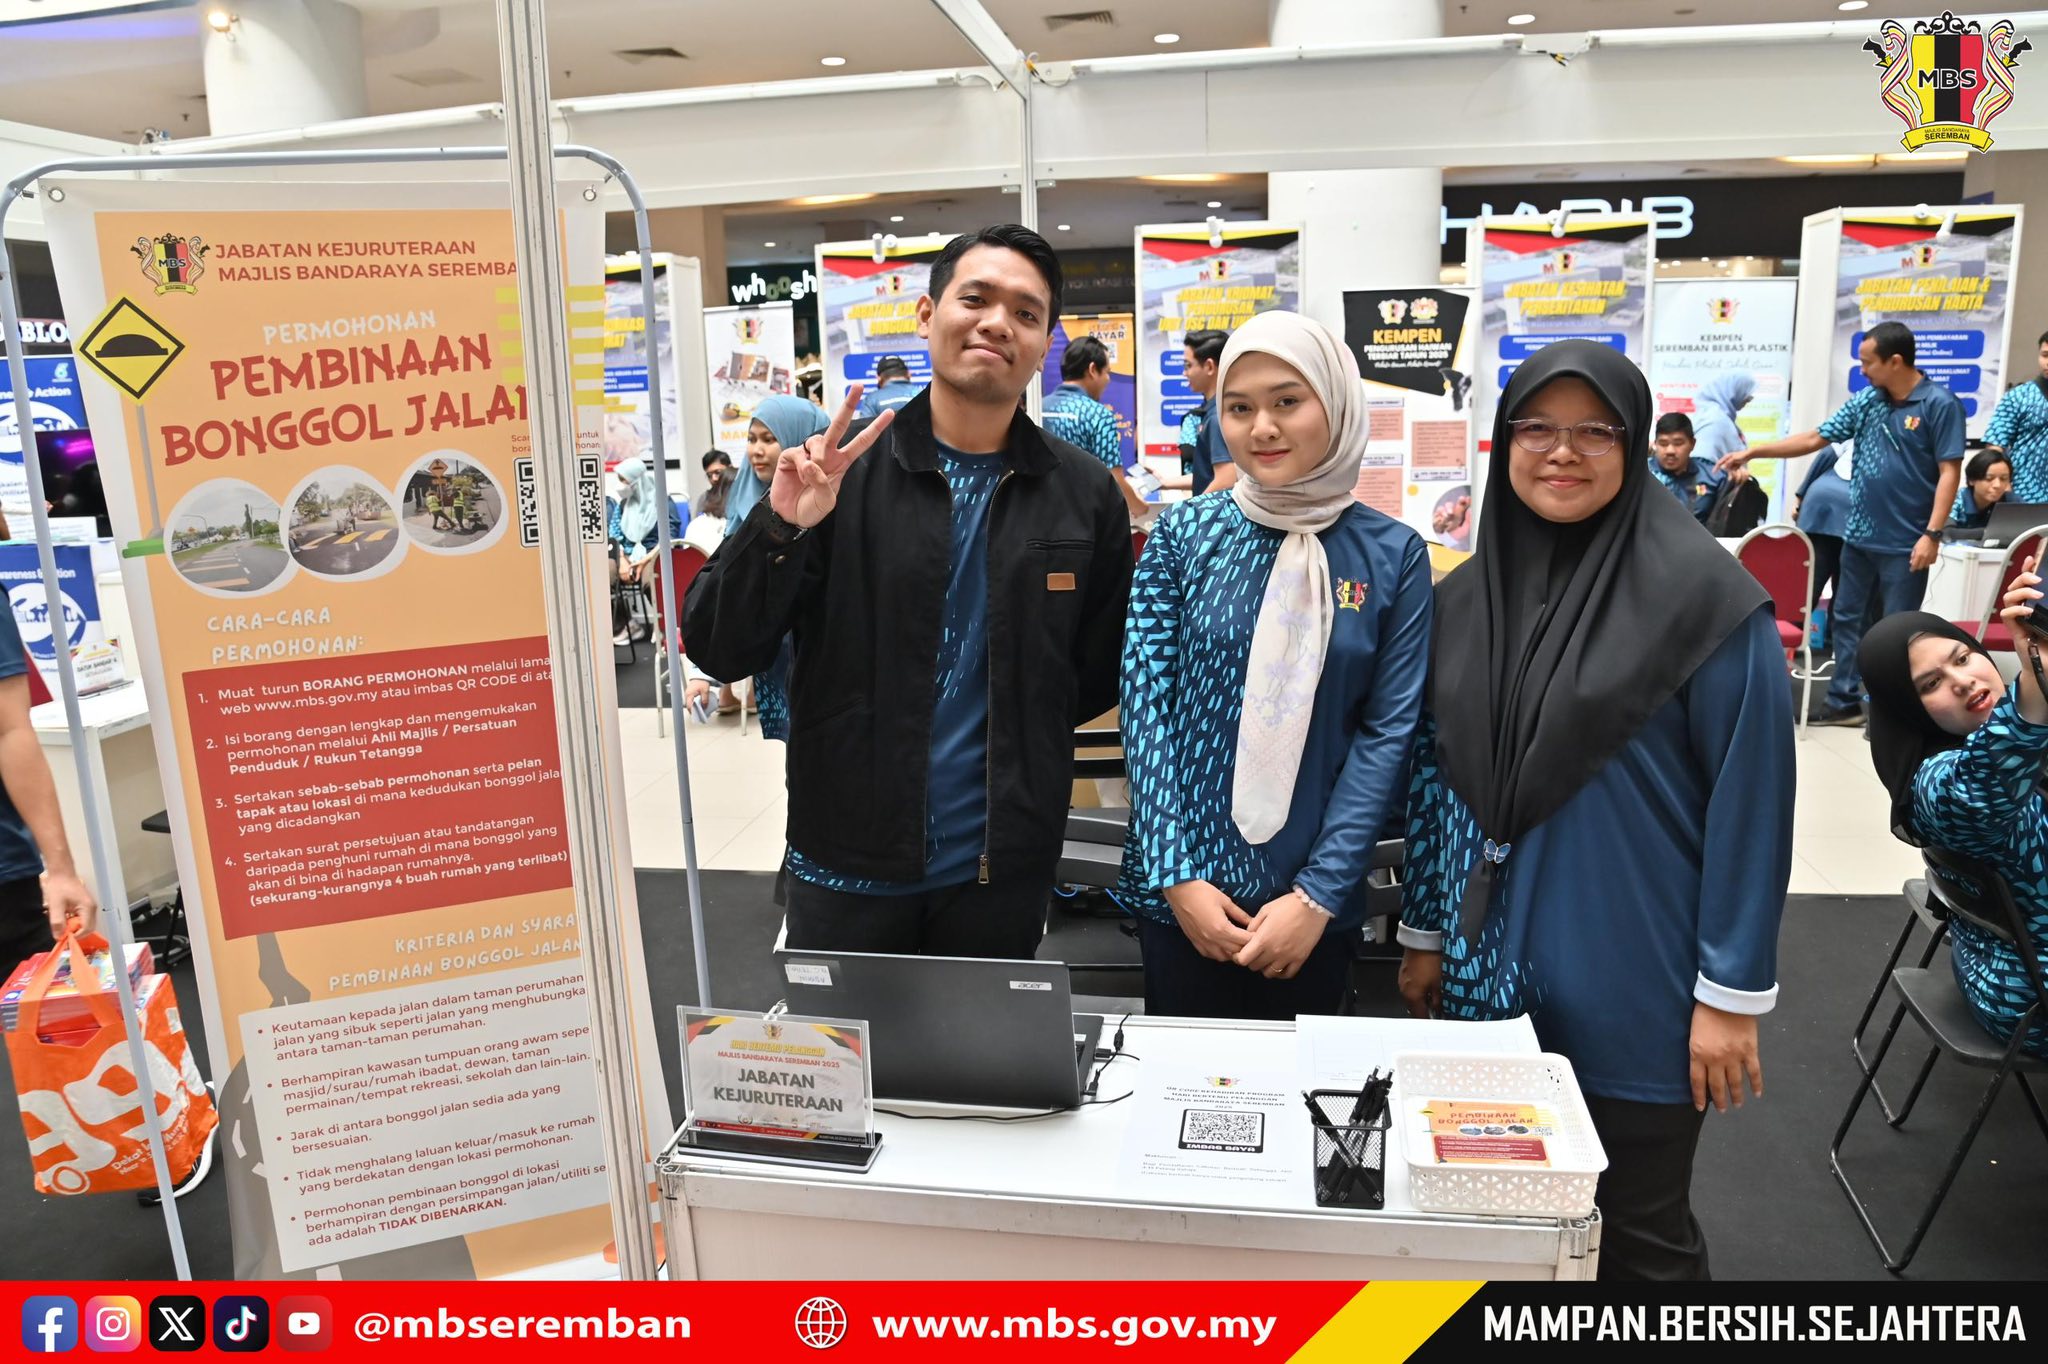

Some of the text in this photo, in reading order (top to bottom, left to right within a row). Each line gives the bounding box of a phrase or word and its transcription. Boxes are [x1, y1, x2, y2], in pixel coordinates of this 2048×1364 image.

[158, 258, 186, 268] MBS
[215, 240, 476, 259] JABATAN KEJURUTERAAN
[218, 261, 518, 282] MAJLIS BANDARAYA SEREMBA
[731, 269, 818, 303] whoosh
[1859, 295, 1985, 311] PENGURUSAN HARTA
[262, 310, 437, 346] PERMOHONAN
[1373, 328, 1442, 344] KEMPEN
[1700, 334, 1743, 342] KEMPEN
[1400, 351, 1428, 359] TAHUN
[1654, 344, 1789, 352] SEREMBAN BEBAS PLASTIK
[210, 333, 493, 400] PEMBINAAN
[34, 386, 73, 398] Action
[160, 403, 395, 468] BONGGOL
[206, 606, 331, 633] CARA-CARA
[211, 635, 365, 665] PERMOHONAN:
[198, 693, 208, 703] 1.
[218, 686, 255, 700] Muat
[261, 684, 299, 695] turun
[302, 675, 363, 691] BORANG
[366, 664, 467, 685] PERMOHONAN
[471, 658, 517, 673] melalui
[205, 702, 537, 749] 2. Isi borang dengan lengkap dan mengemukakan
[227, 719, 517, 762] permohonan melalui Ahli Majlis / Persatuan
[229, 745, 423, 775] Penduduk / Rukun Tetangga
[224, 816, 534, 866] 4. Sertakan surat persetujuan atau tandatangan
[250, 850, 567, 907] (sekurang-kurangnya 4 buah rumah yang terlibat)
[395, 914, 578, 954] KRITERIA DAN SYARA
[328, 960, 434, 992] PEMBINAAN
[440, 945, 524, 972] BONGGOL
[276, 1019, 486, 1061] antara taman-taman perumahan.
[283, 1047, 550, 1101] masjid/surau/rumah ibadat, dewan, taman
[717, 1051, 841, 1069] MAJLIS BANDARAYA SEREMBAN 2025
[738, 1068, 815, 1089] JABATAN
[713, 1086, 843, 1112] KEJURUTERAAN
[292, 1134, 372, 1154] bersesuaian.
[299, 1134, 573, 1196] yang berdekatan dengan lokasi permohonan.
[304, 1159, 560, 1220] Permohonan pembinaan bonggol di lokasi
[308, 1197, 507, 1246] ada adalah TIDAK DIBENARKAN.
